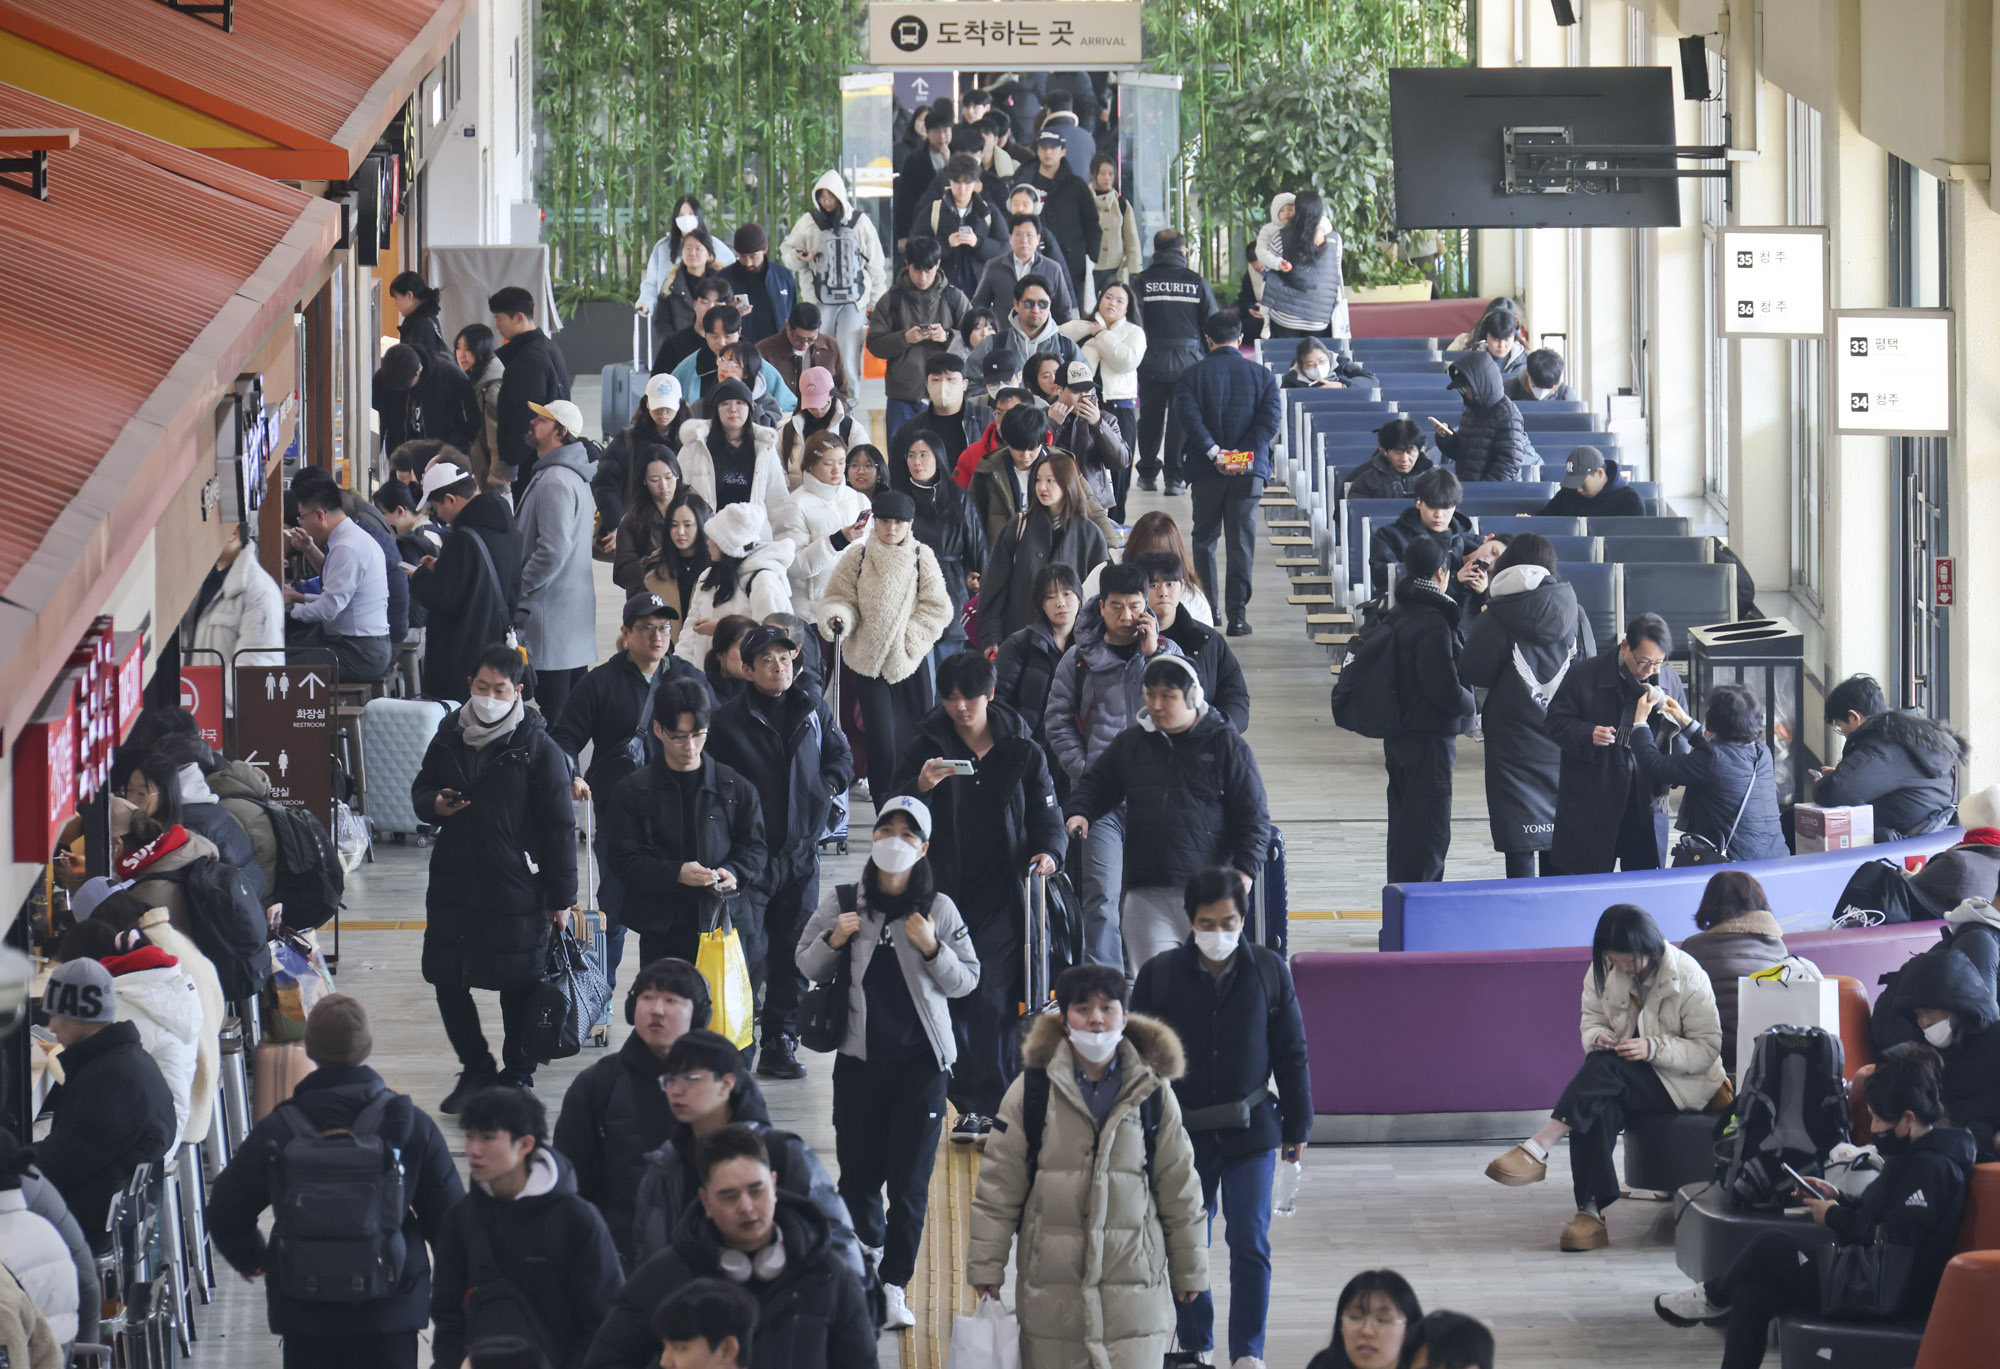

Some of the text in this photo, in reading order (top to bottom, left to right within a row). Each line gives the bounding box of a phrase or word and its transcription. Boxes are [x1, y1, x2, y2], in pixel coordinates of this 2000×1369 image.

[936, 20, 1074, 46] 도착하는 곳
[1080, 36, 1126, 46] ARRIVAL
[1737, 253, 1753, 266] 35
[1145, 282, 1199, 294] SECURITY
[1738, 303, 1754, 315] 36
[1851, 338, 1899, 353] 33 평택
[1851, 393, 1899, 409] 34 청주
[296, 708, 326, 720] 화장실
[270, 786, 290, 798] 장실
